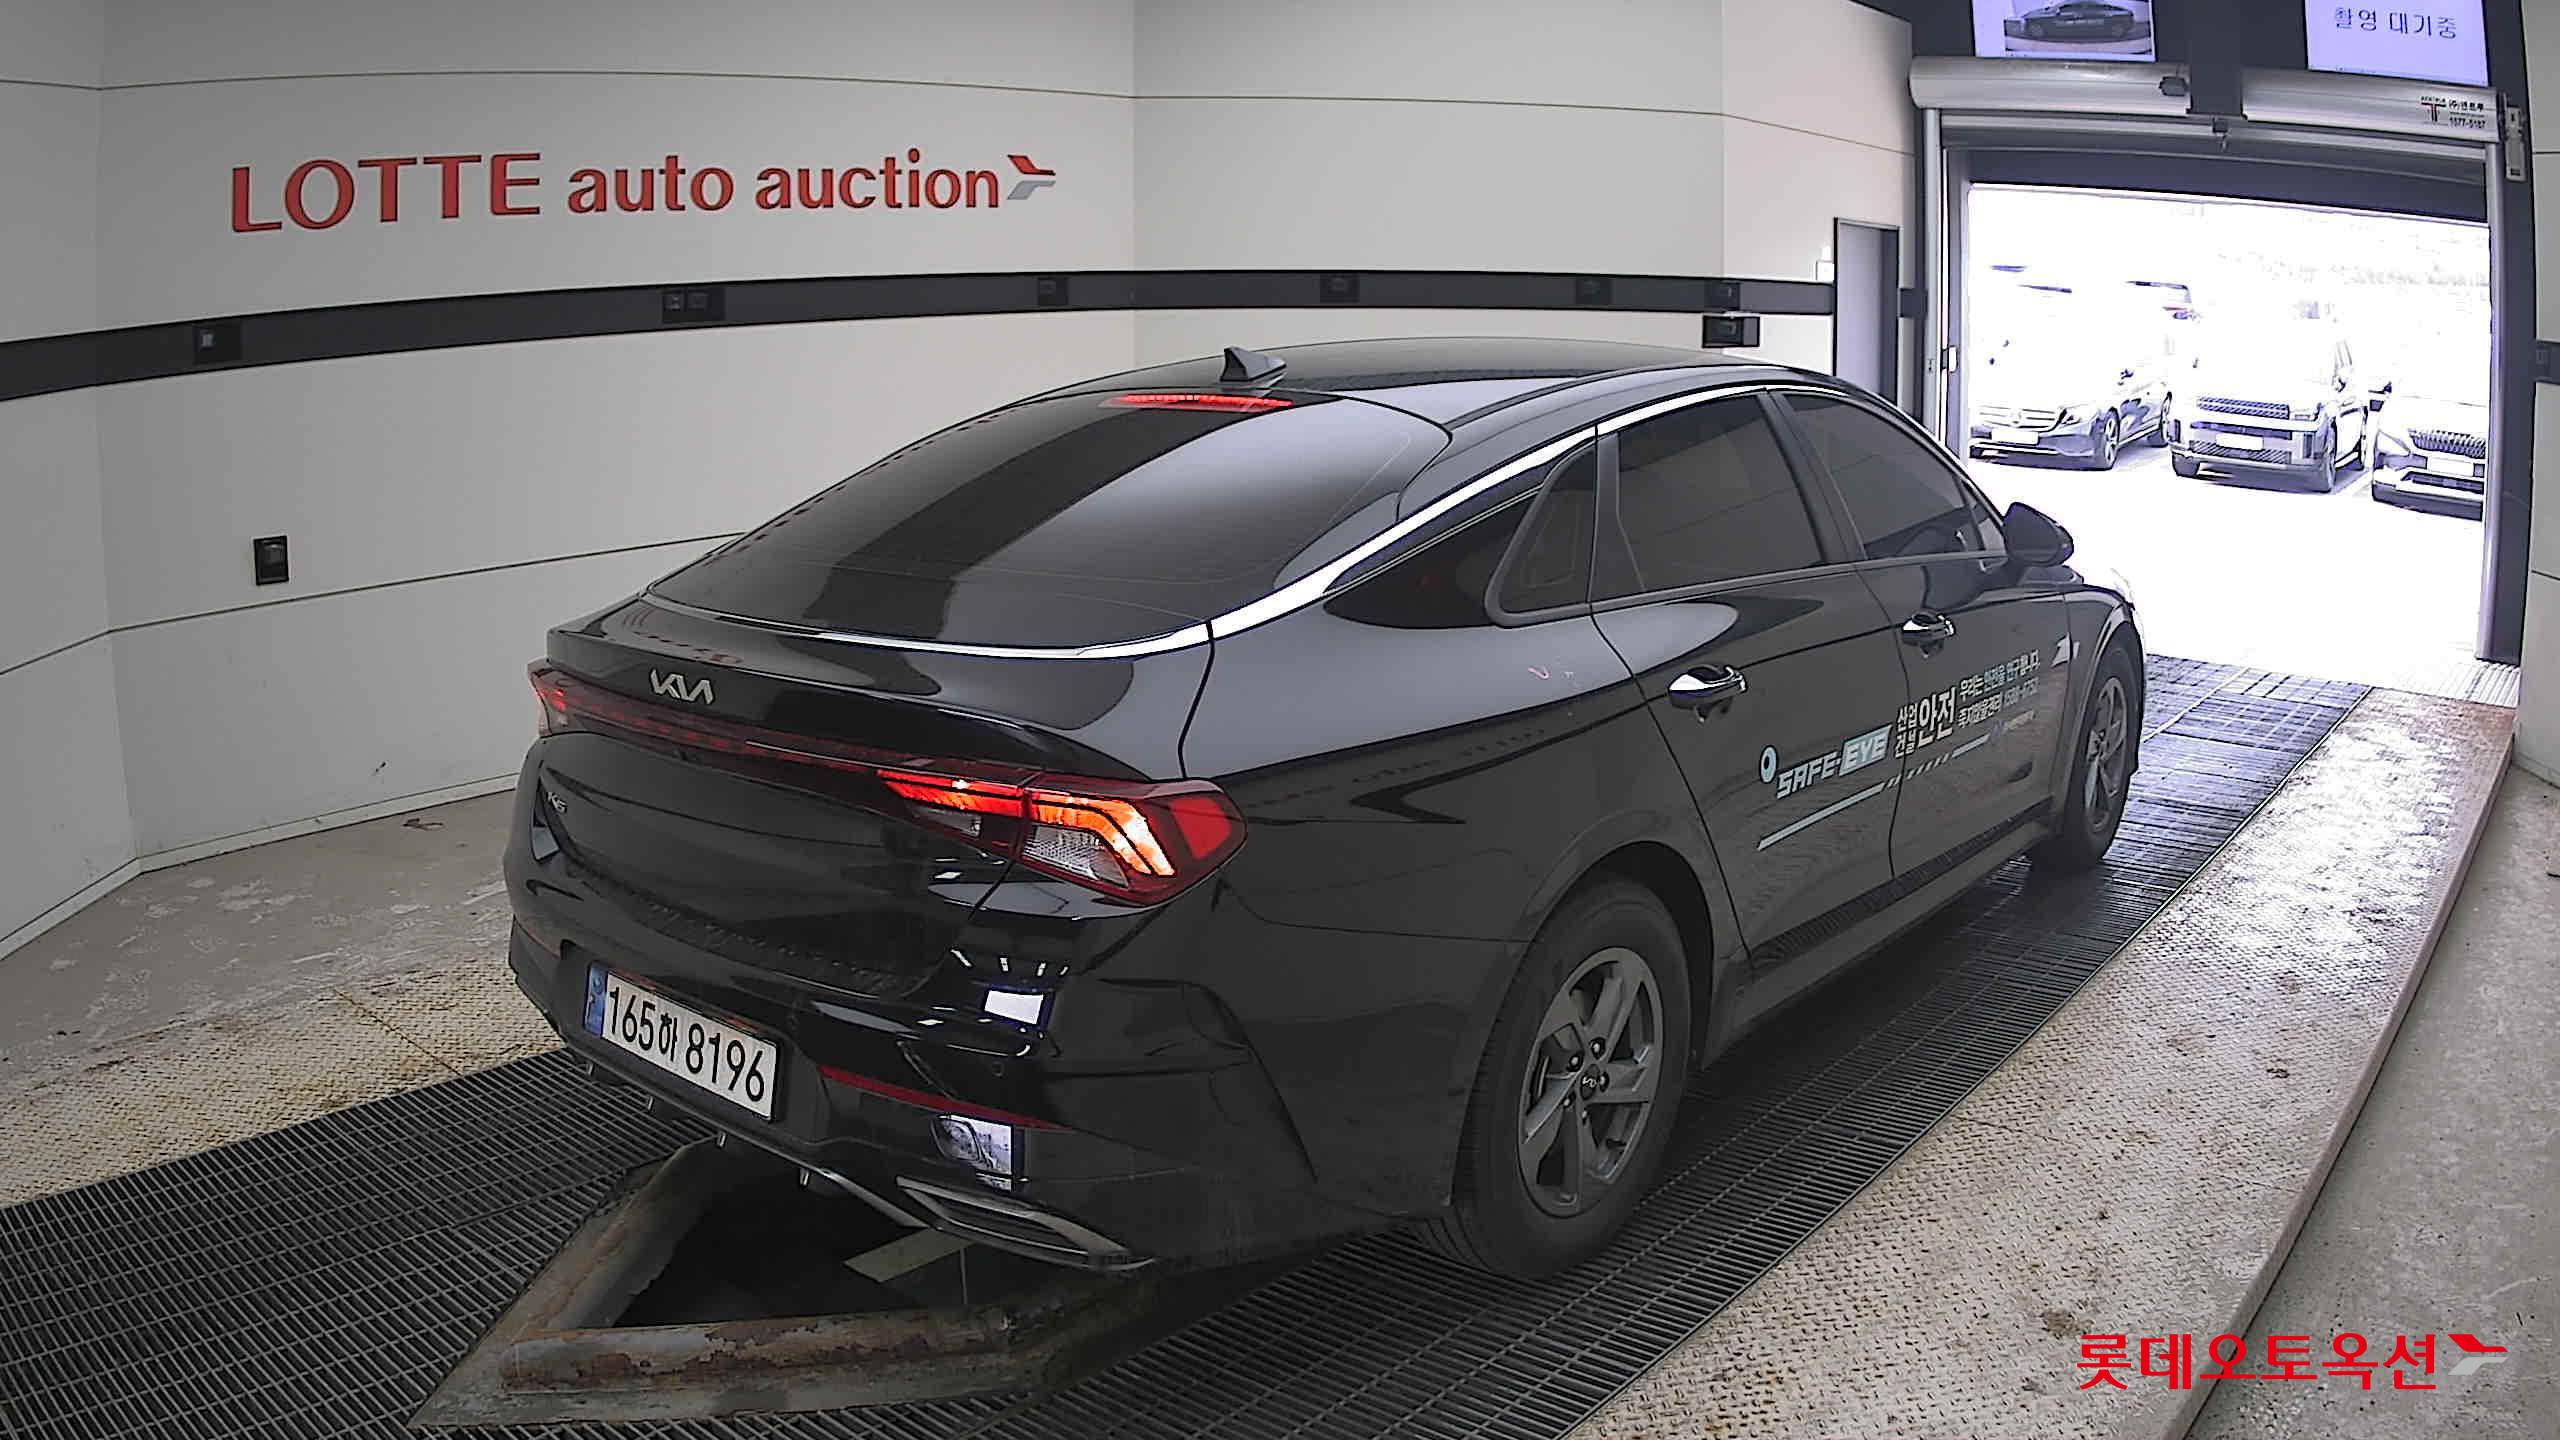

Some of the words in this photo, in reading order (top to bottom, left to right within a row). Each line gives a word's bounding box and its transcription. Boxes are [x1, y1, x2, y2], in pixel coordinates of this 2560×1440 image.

[2389, 12, 2456, 39] 대기중
[231, 152, 541, 233] LOTTE
[567, 154, 734, 213] auto
[755, 147, 999, 209] auction
[1918, 686, 1955, 748] 안전
[609, 986, 678, 1063] 165하
[685, 1023, 765, 1102] 8196
